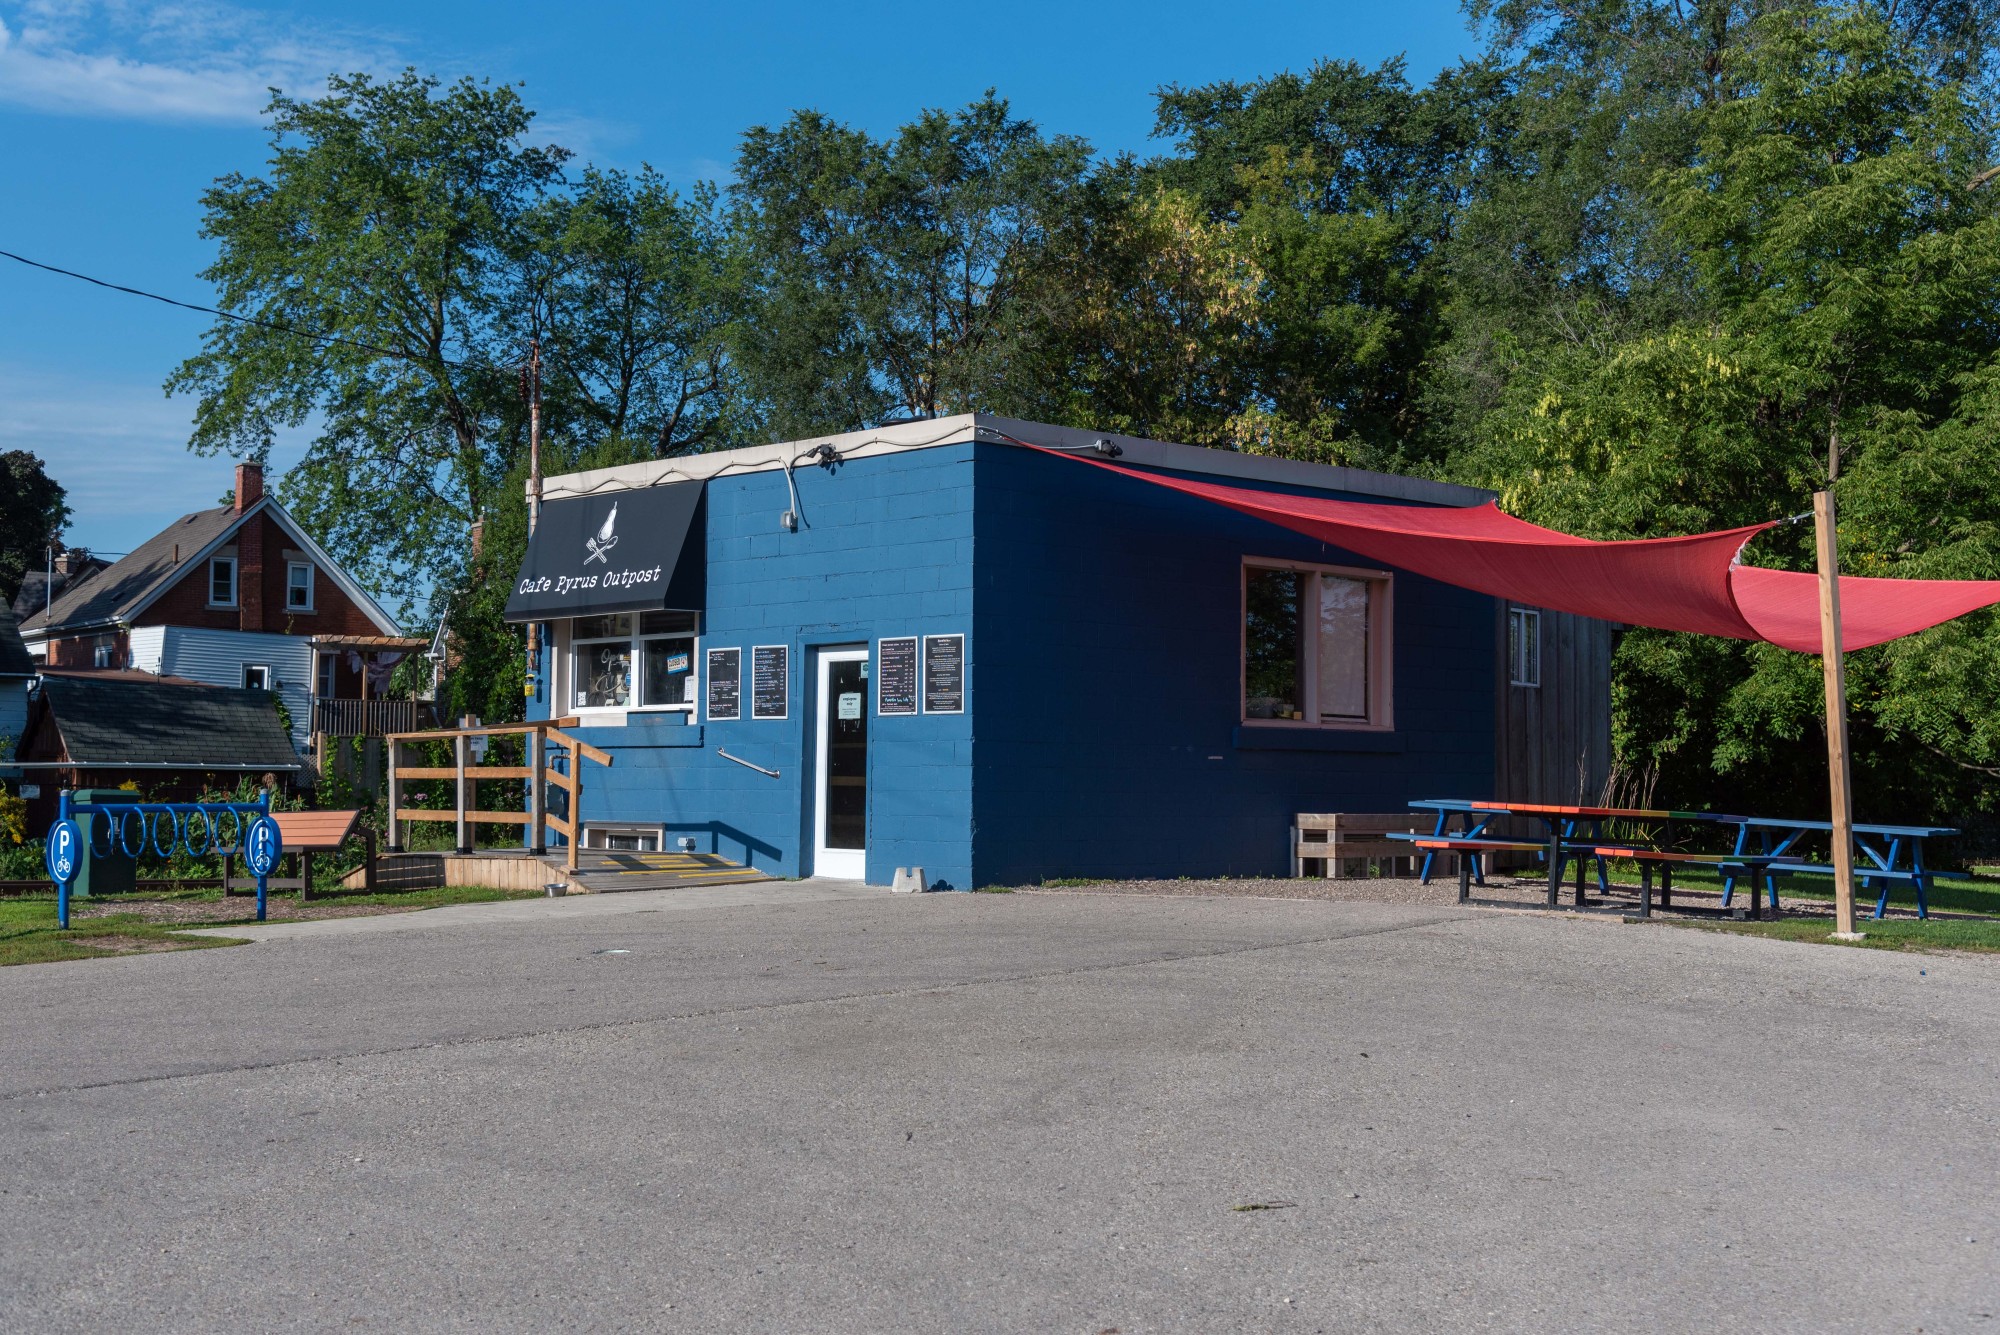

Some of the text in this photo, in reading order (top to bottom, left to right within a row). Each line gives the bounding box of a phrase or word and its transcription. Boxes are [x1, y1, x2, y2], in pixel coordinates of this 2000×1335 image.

[519, 565, 662, 595] Cafe Pyrus Outpost
[59, 830, 70, 855] P
[258, 826, 269, 850] P
